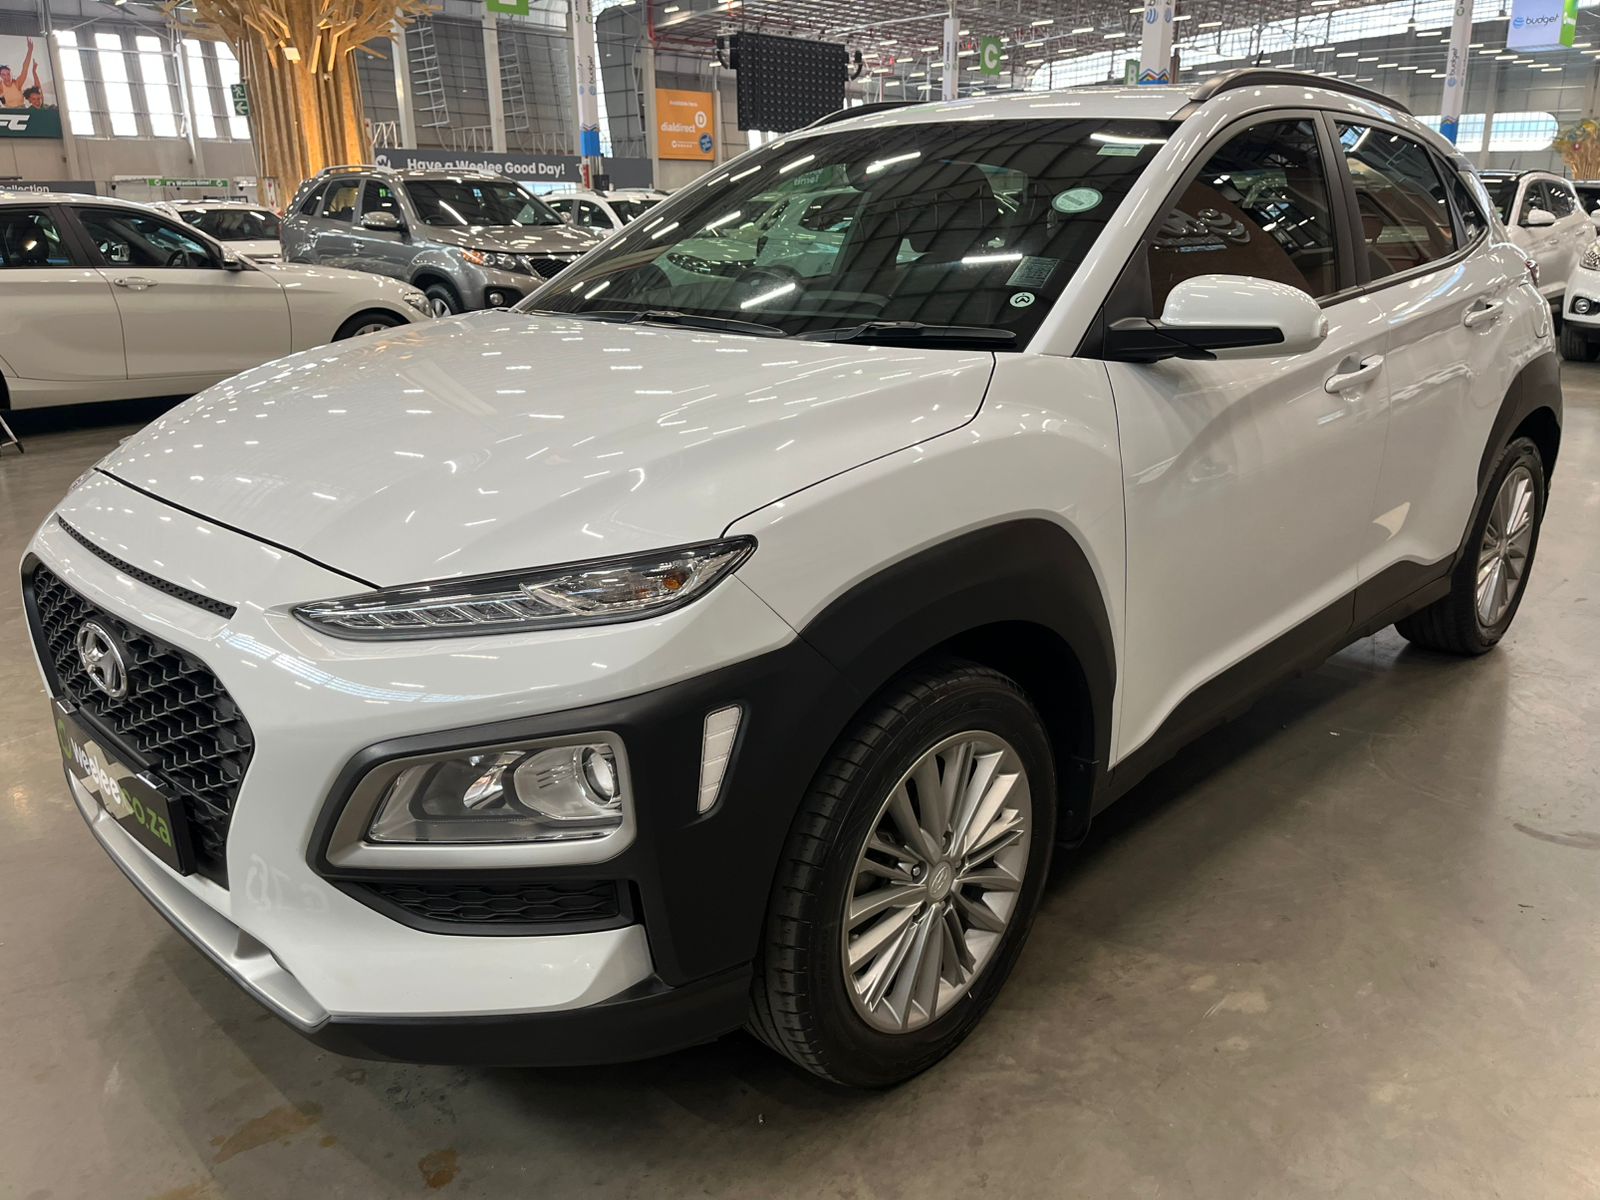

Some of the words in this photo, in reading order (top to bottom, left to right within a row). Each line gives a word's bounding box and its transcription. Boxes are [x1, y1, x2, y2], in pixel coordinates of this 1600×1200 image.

[1525, 13, 1559, 26] budget
[984, 43, 998, 69] C
[407, 158, 442, 170] Have
[504, 162, 537, 174] Good
[538, 163, 566, 179] Day!
